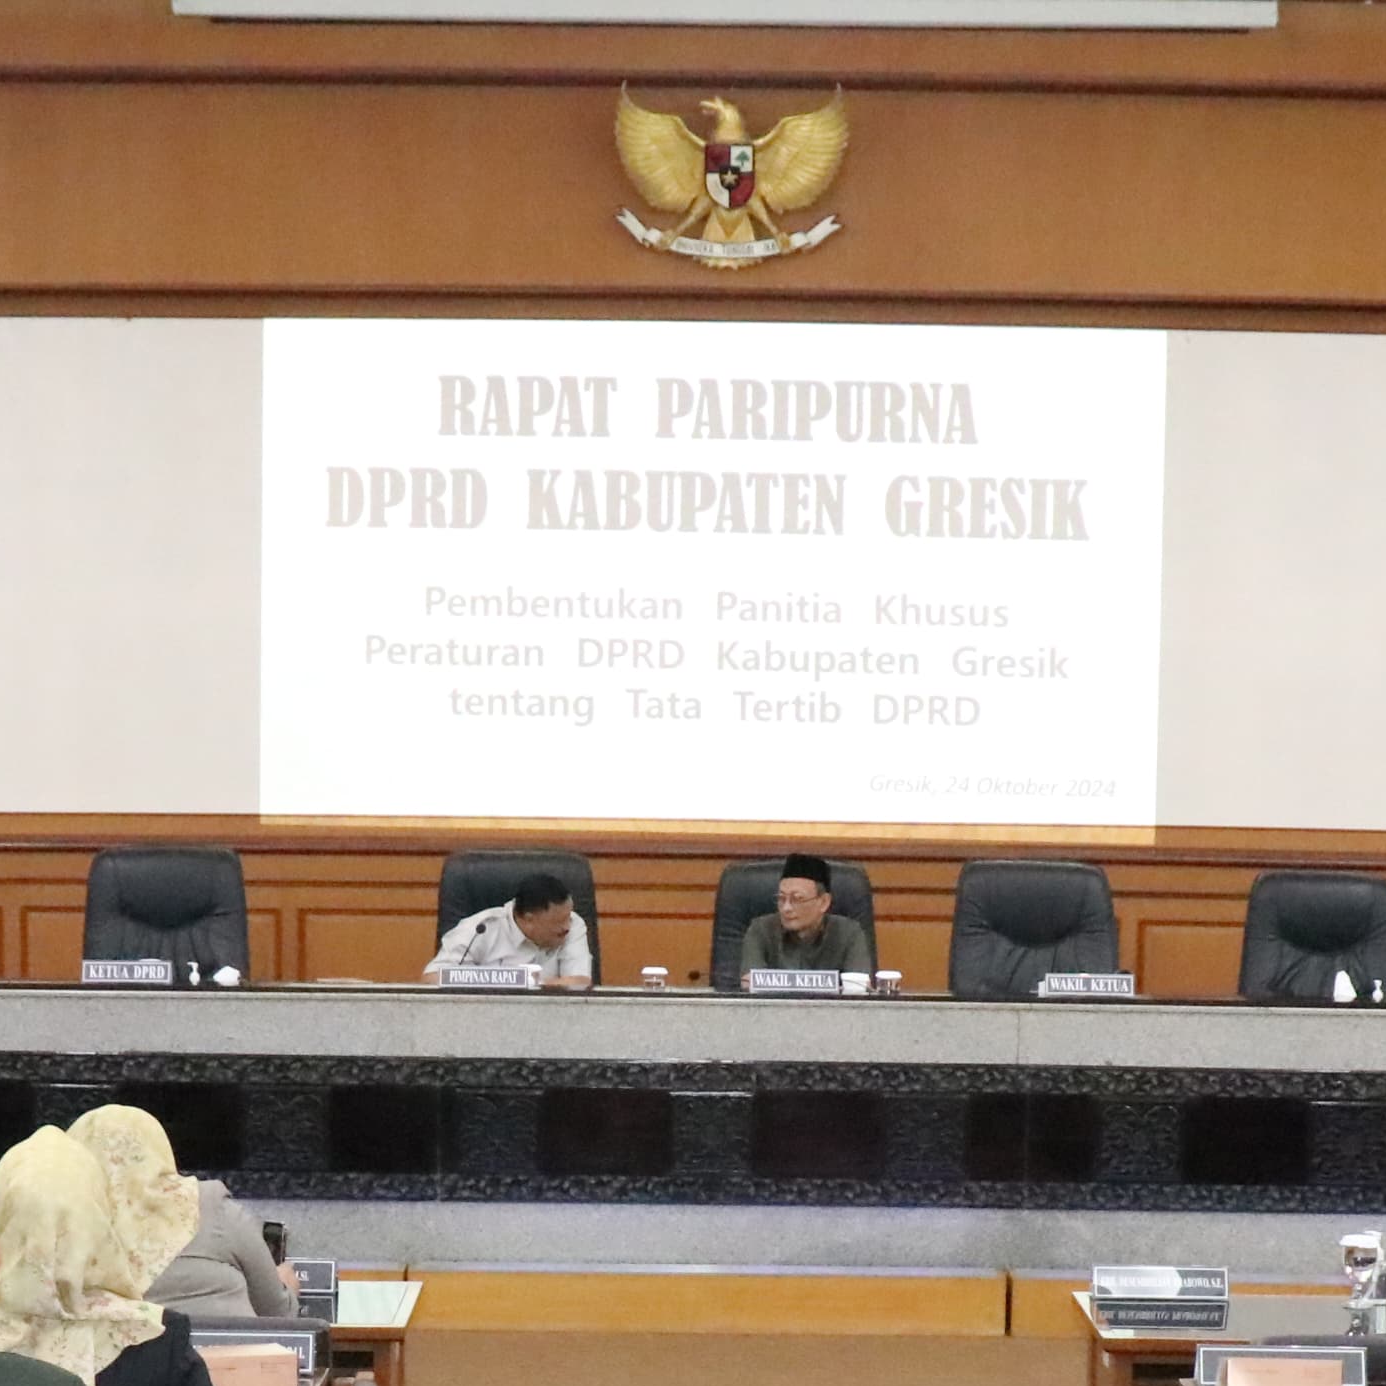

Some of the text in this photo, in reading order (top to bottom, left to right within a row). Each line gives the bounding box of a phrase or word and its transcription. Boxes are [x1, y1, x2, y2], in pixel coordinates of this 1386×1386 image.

[437, 375, 979, 445] RAPAT PARIPURNA
[325, 466, 1090, 542] DPRD KABUPATEN GRESIK
[425, 586, 1009, 628] Pembentukan Panitia Khusus
[365, 635, 1069, 682] Peraturan DPRD Kabupaten Gresik
[448, 688, 981, 728] tentang Tata Tertib DPRD
[869, 774, 938, 797] Gresik,
[977, 777, 1059, 797] Oktober
[1065, 779, 1117, 798] 2024
[89, 964, 165, 979] KETUA DPRD
[449, 969, 518, 984] PIMPINAN RAPAT
[755, 973, 833, 987] WAKIL KETUA
[1049, 977, 1129, 992] WAKIL KETUA
